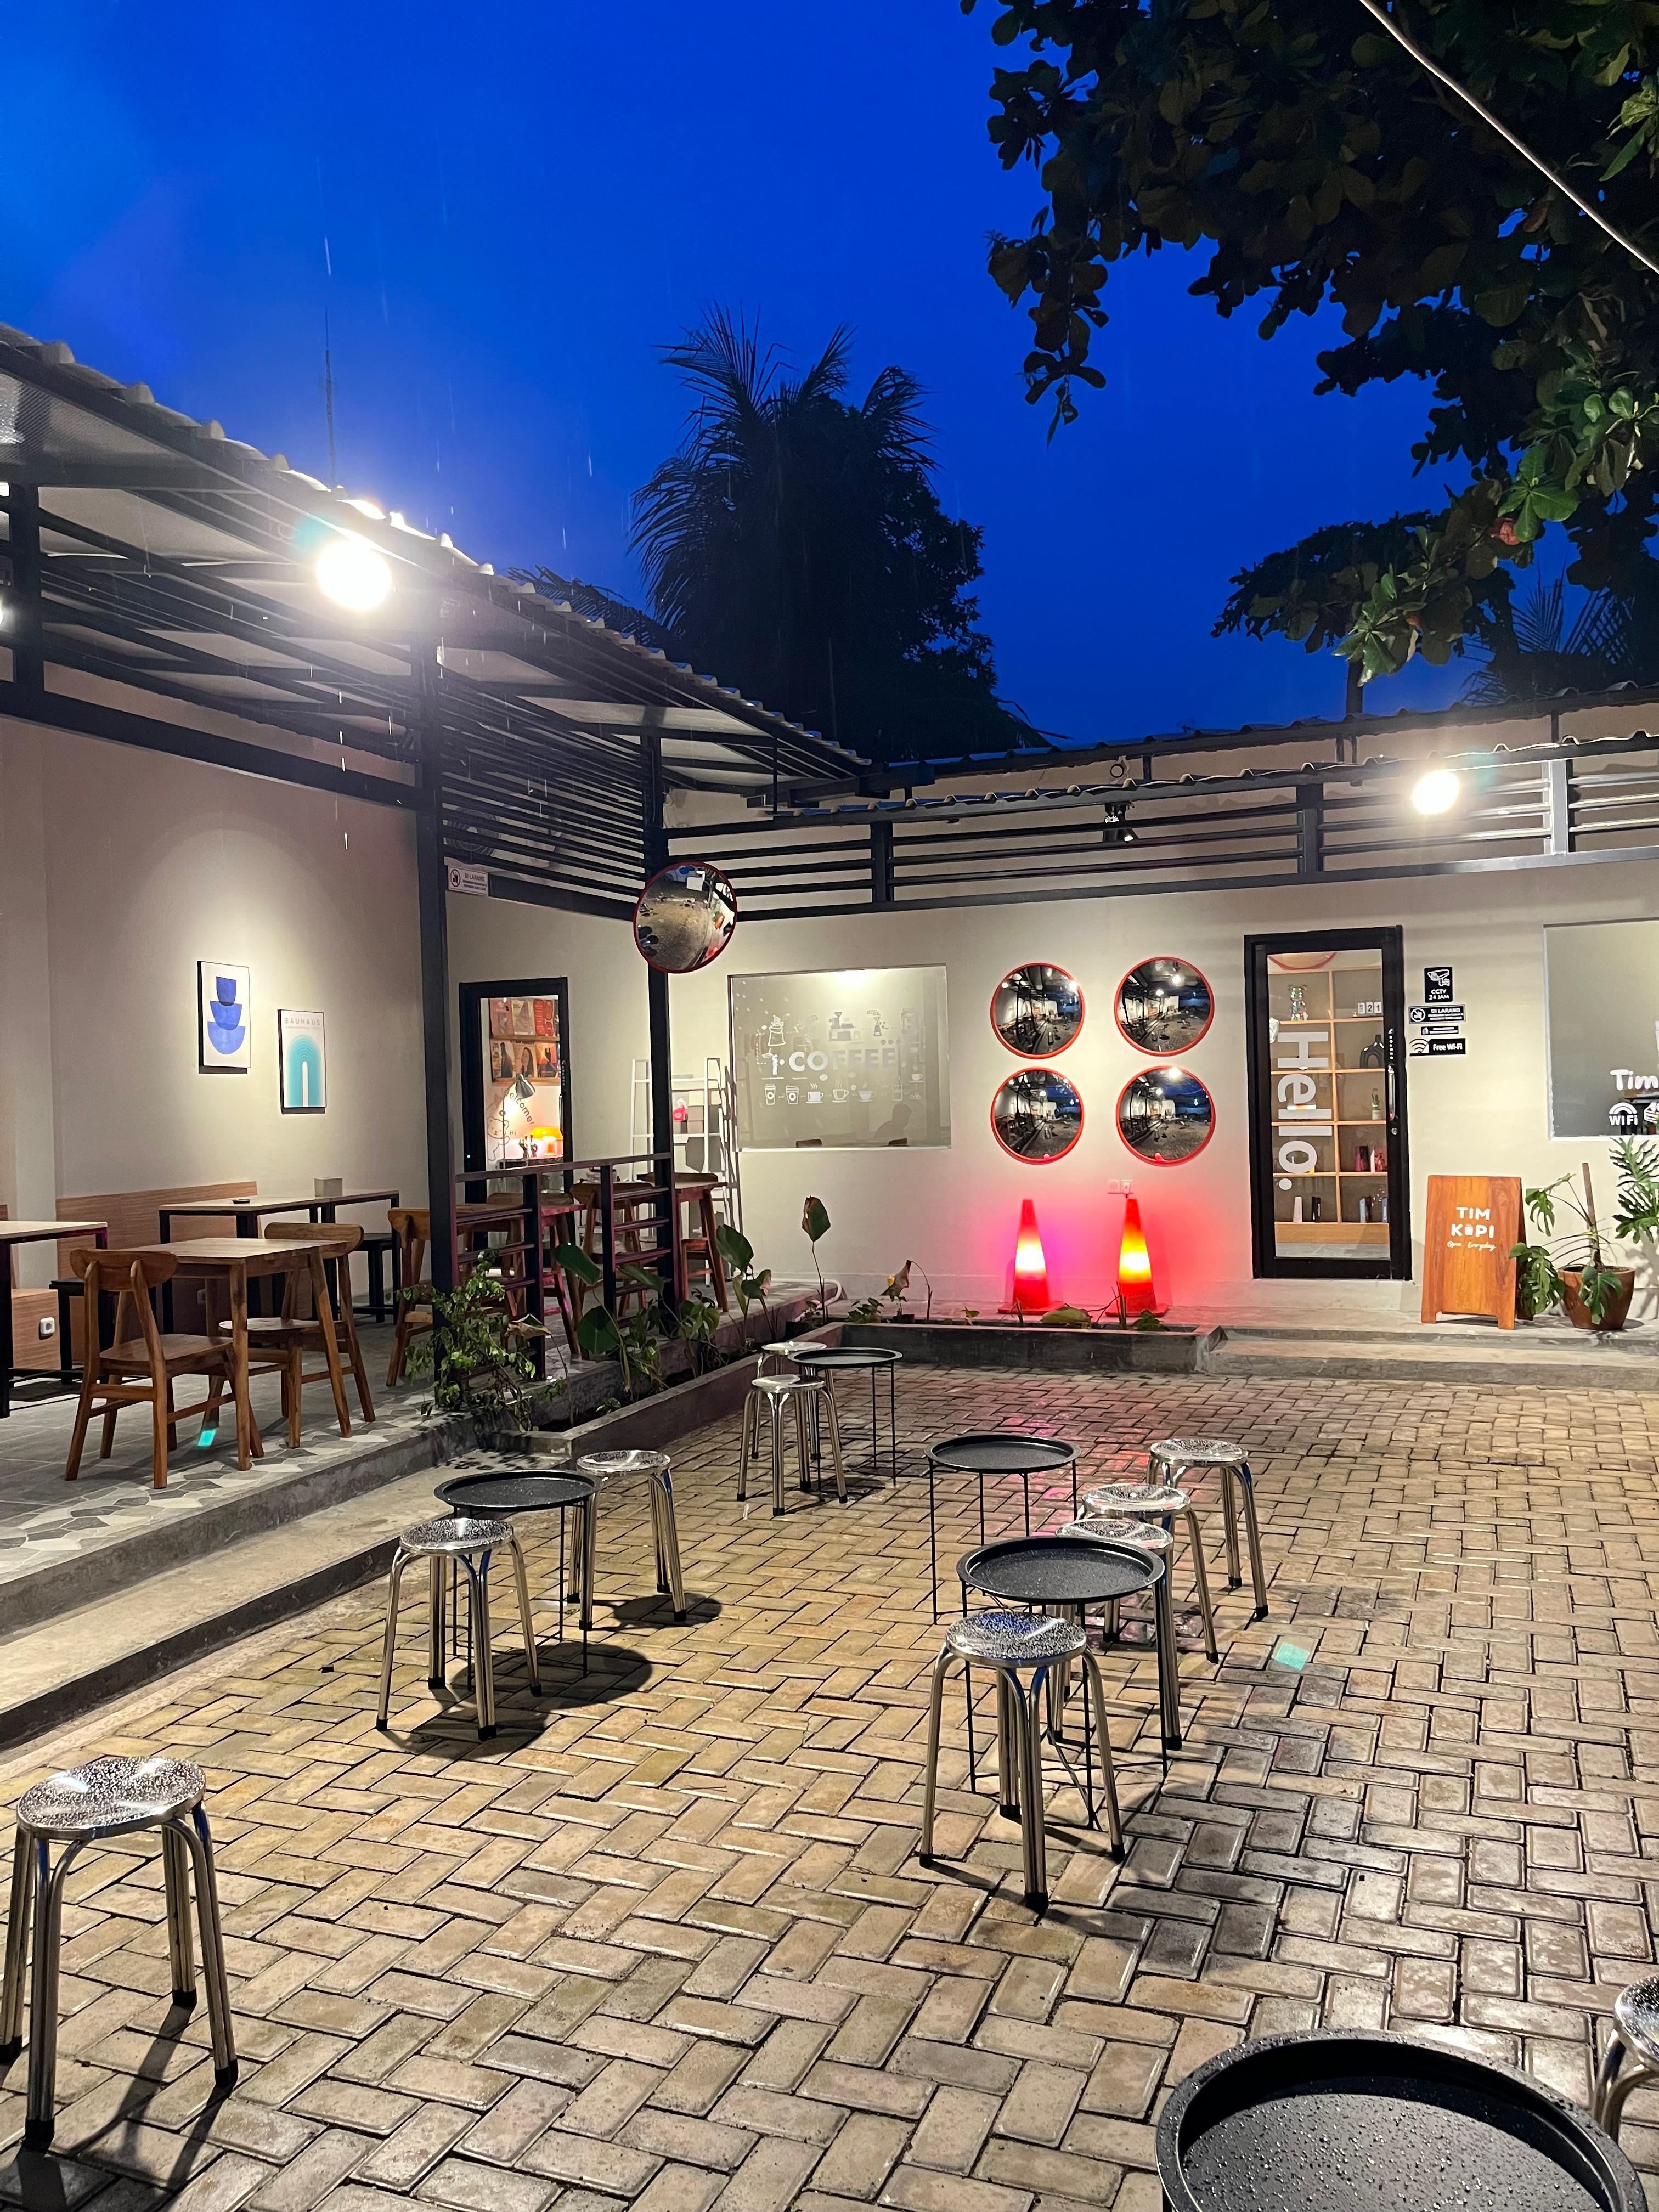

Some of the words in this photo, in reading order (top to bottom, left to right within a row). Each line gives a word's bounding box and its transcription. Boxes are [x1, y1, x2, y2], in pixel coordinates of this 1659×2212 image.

[285, 1017, 321, 1026] BAUHAUS
[788, 1048, 896, 1072] COFFEE
[1610, 1069, 1658, 1091] Tim
[1277, 1031, 1333, 1190] Hello.
[1455, 1206, 1491, 1221] TIM
[1467, 1241, 1496, 1252] Everyday
